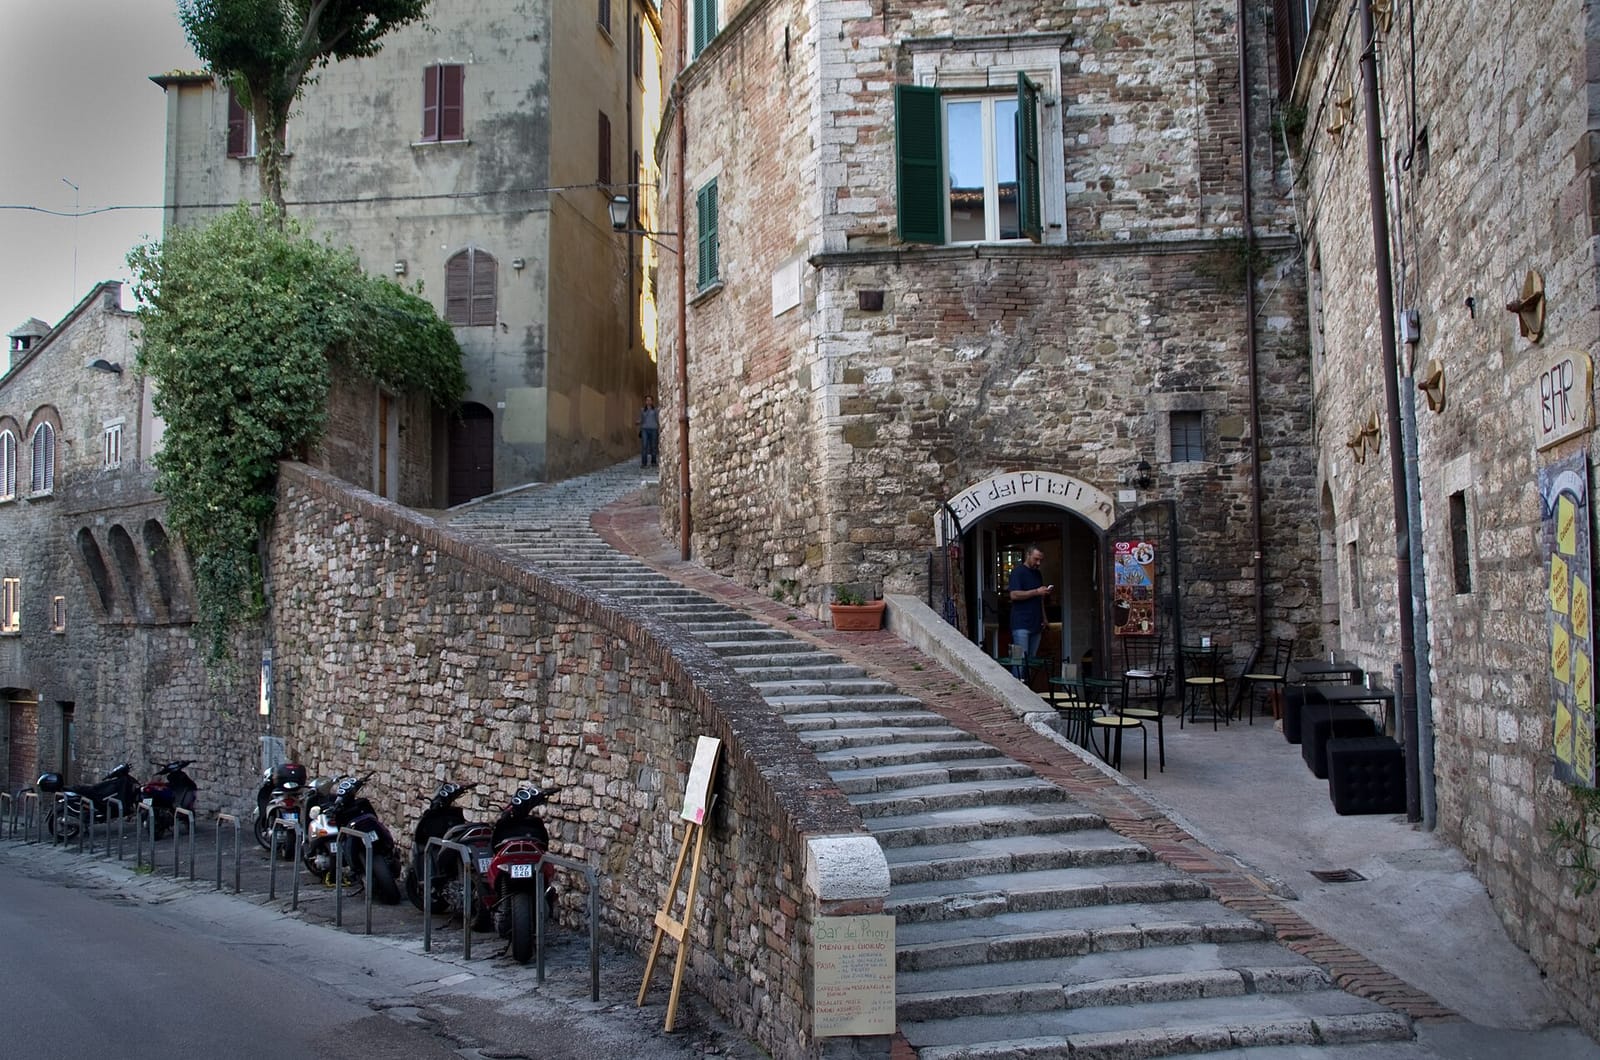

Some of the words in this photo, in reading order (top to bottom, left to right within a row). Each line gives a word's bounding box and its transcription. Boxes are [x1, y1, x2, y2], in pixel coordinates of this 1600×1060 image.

[1540, 359, 1576, 434] BAR
[950, 490, 980, 520] Bar
[988, 479, 1016, 500] dei
[1020, 473, 1082, 500] Priori
[816, 920, 841, 940] Bar
[861, 919, 889, 939] Priori
